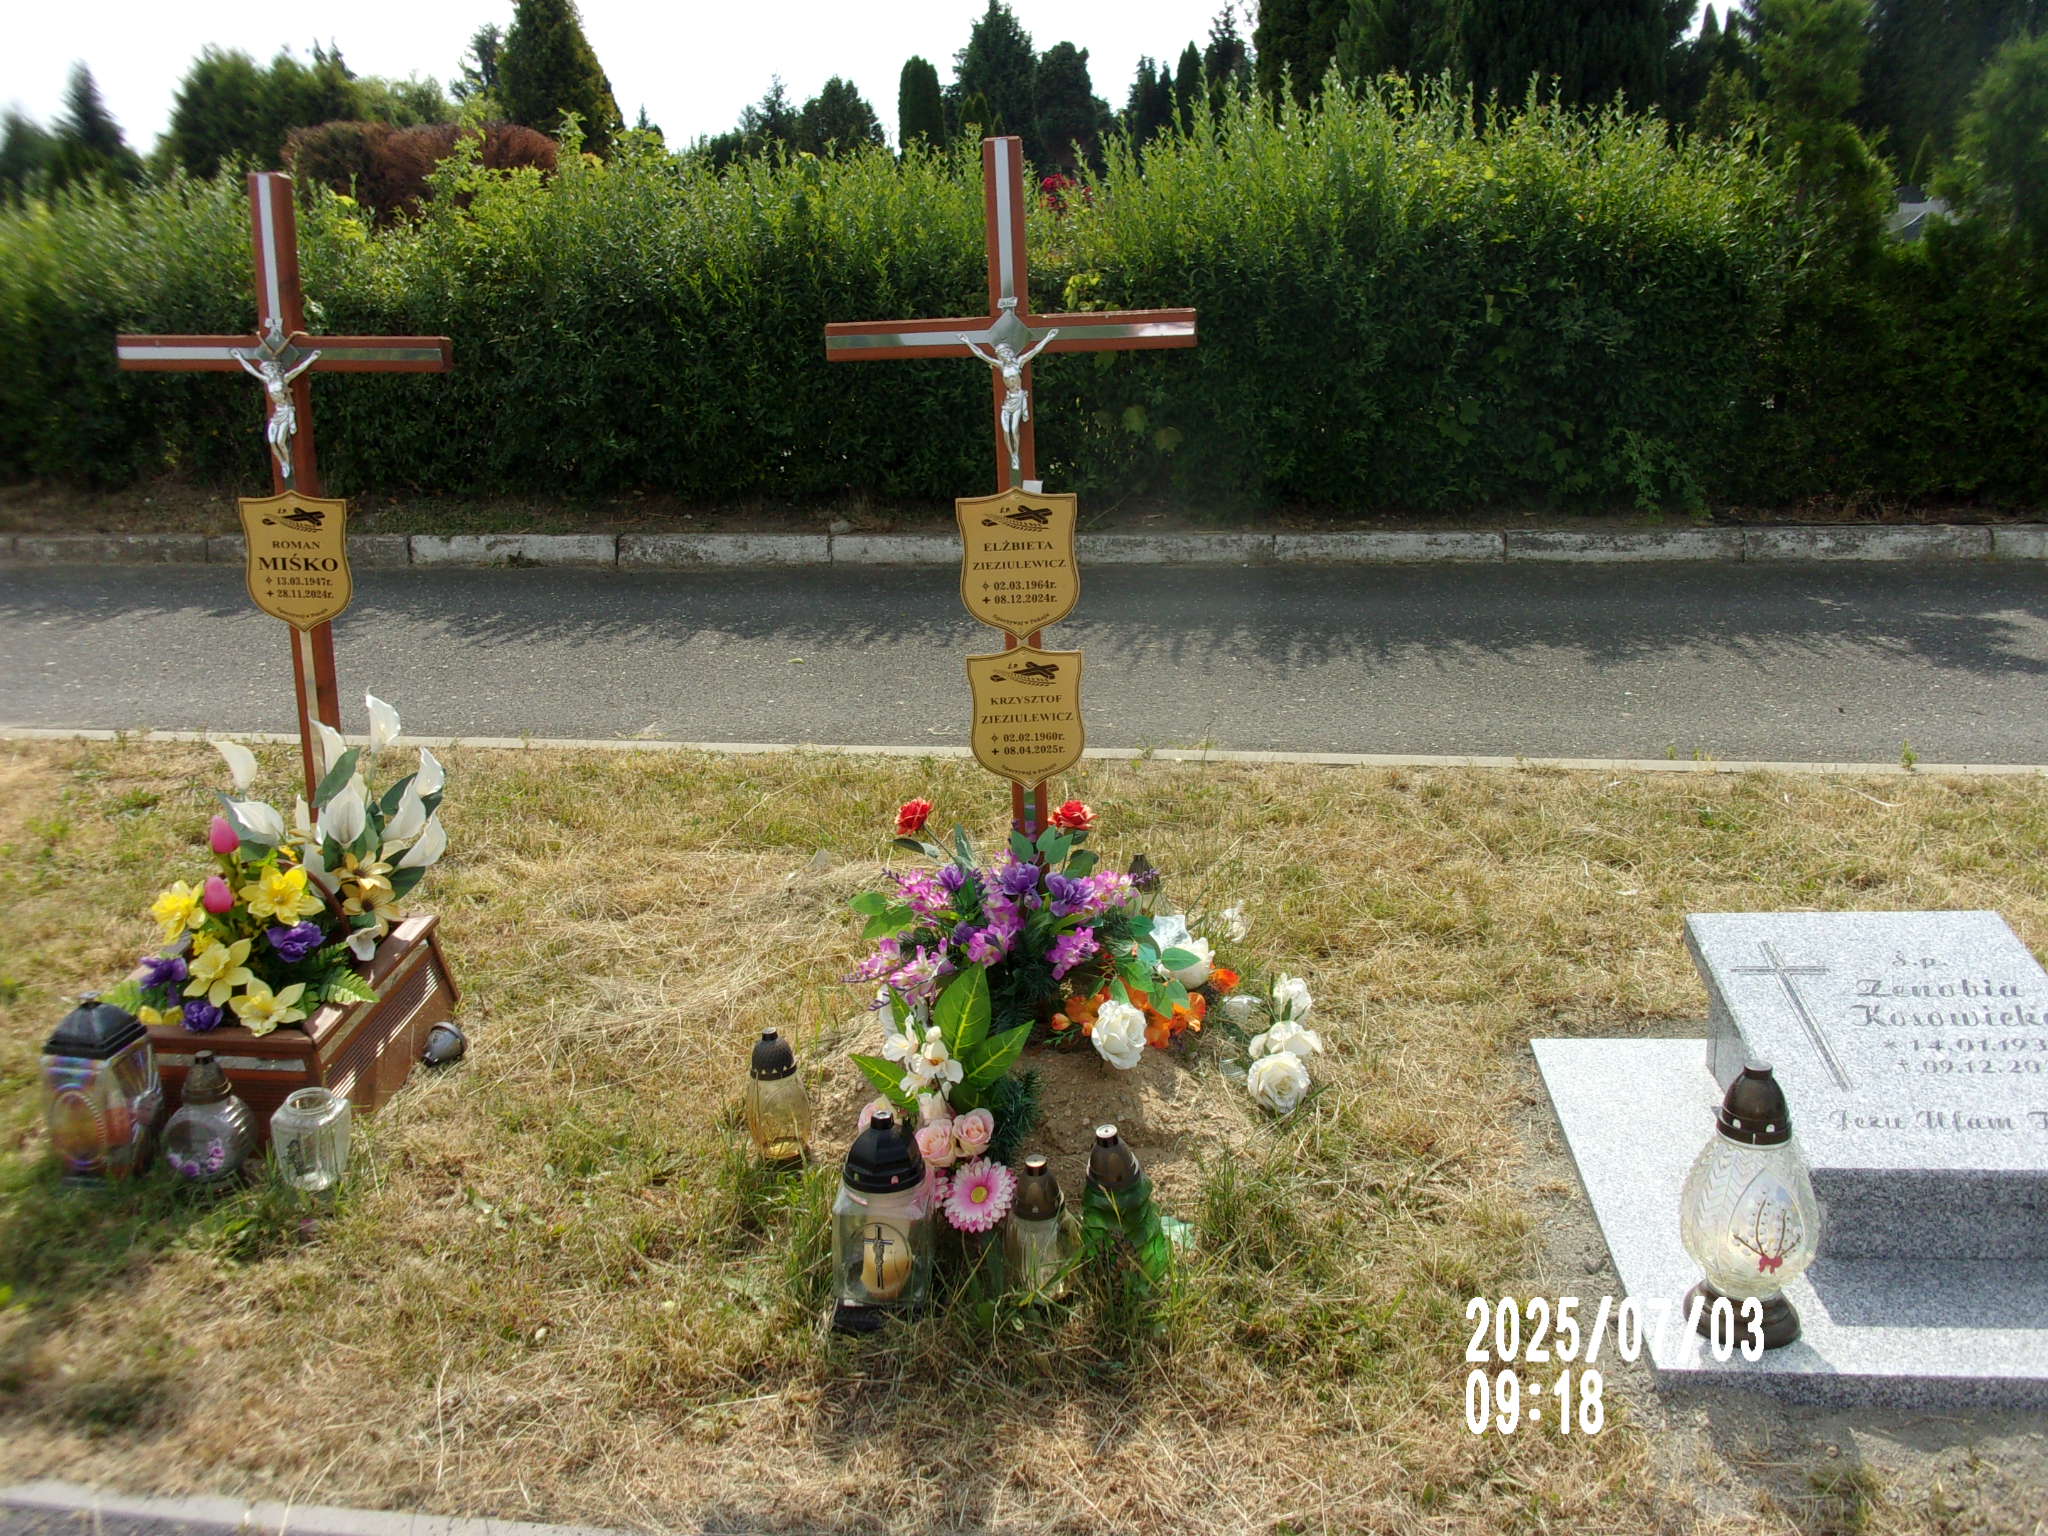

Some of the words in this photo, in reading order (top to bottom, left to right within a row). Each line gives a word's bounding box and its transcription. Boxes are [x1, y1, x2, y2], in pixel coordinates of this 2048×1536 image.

[272, 540, 320, 549] ROMAN
[984, 540, 1054, 552] ELŻBIETA
[258, 553, 338, 572] MIŚKO
[972, 559, 1067, 570] ZIEZIULEWICZ
[990, 695, 1063, 705] KRZYSZTOF
[981, 712, 1074, 724] ZIEZIULEWICZ
[1854, 979, 2024, 998] Zenobia
